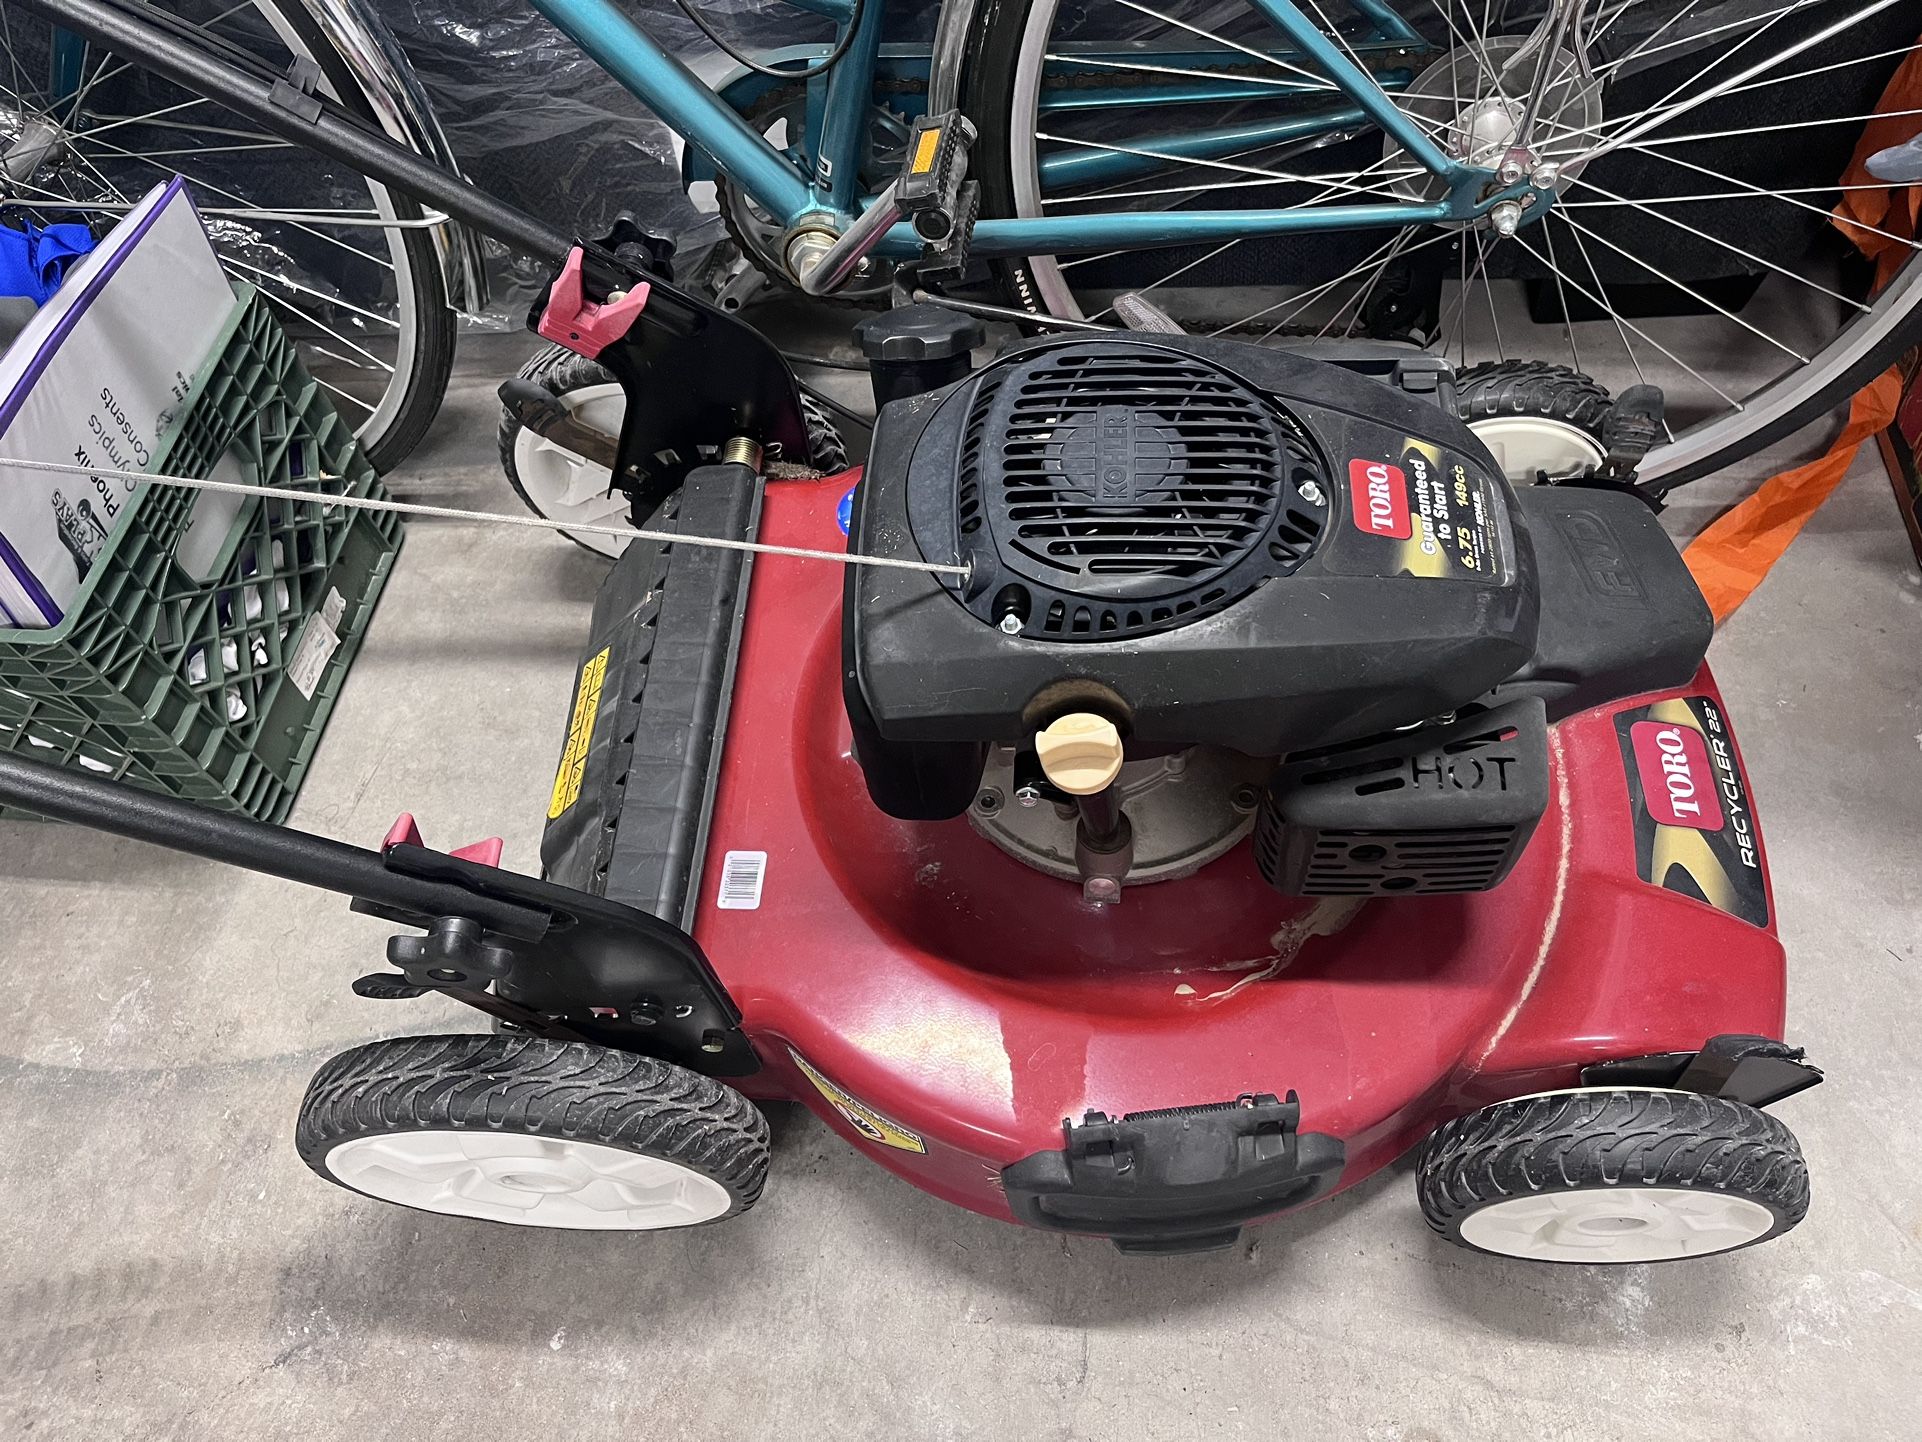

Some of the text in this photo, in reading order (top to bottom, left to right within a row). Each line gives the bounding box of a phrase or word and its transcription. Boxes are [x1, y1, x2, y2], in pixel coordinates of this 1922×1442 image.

[88, 414, 137, 492] Oympics
[100, 388, 149, 466] Consents
[1103, 413, 1128, 498] KOHLER
[52, 489, 88, 546] PLAYS
[1409, 459, 1437, 555] Guaranteed
[1431, 481, 1452, 540] to Start
[1454, 465, 1475, 569] 6.75 149cc
[1411, 757, 1516, 791] HOT
[1712, 738, 1757, 868] RECYCLER
